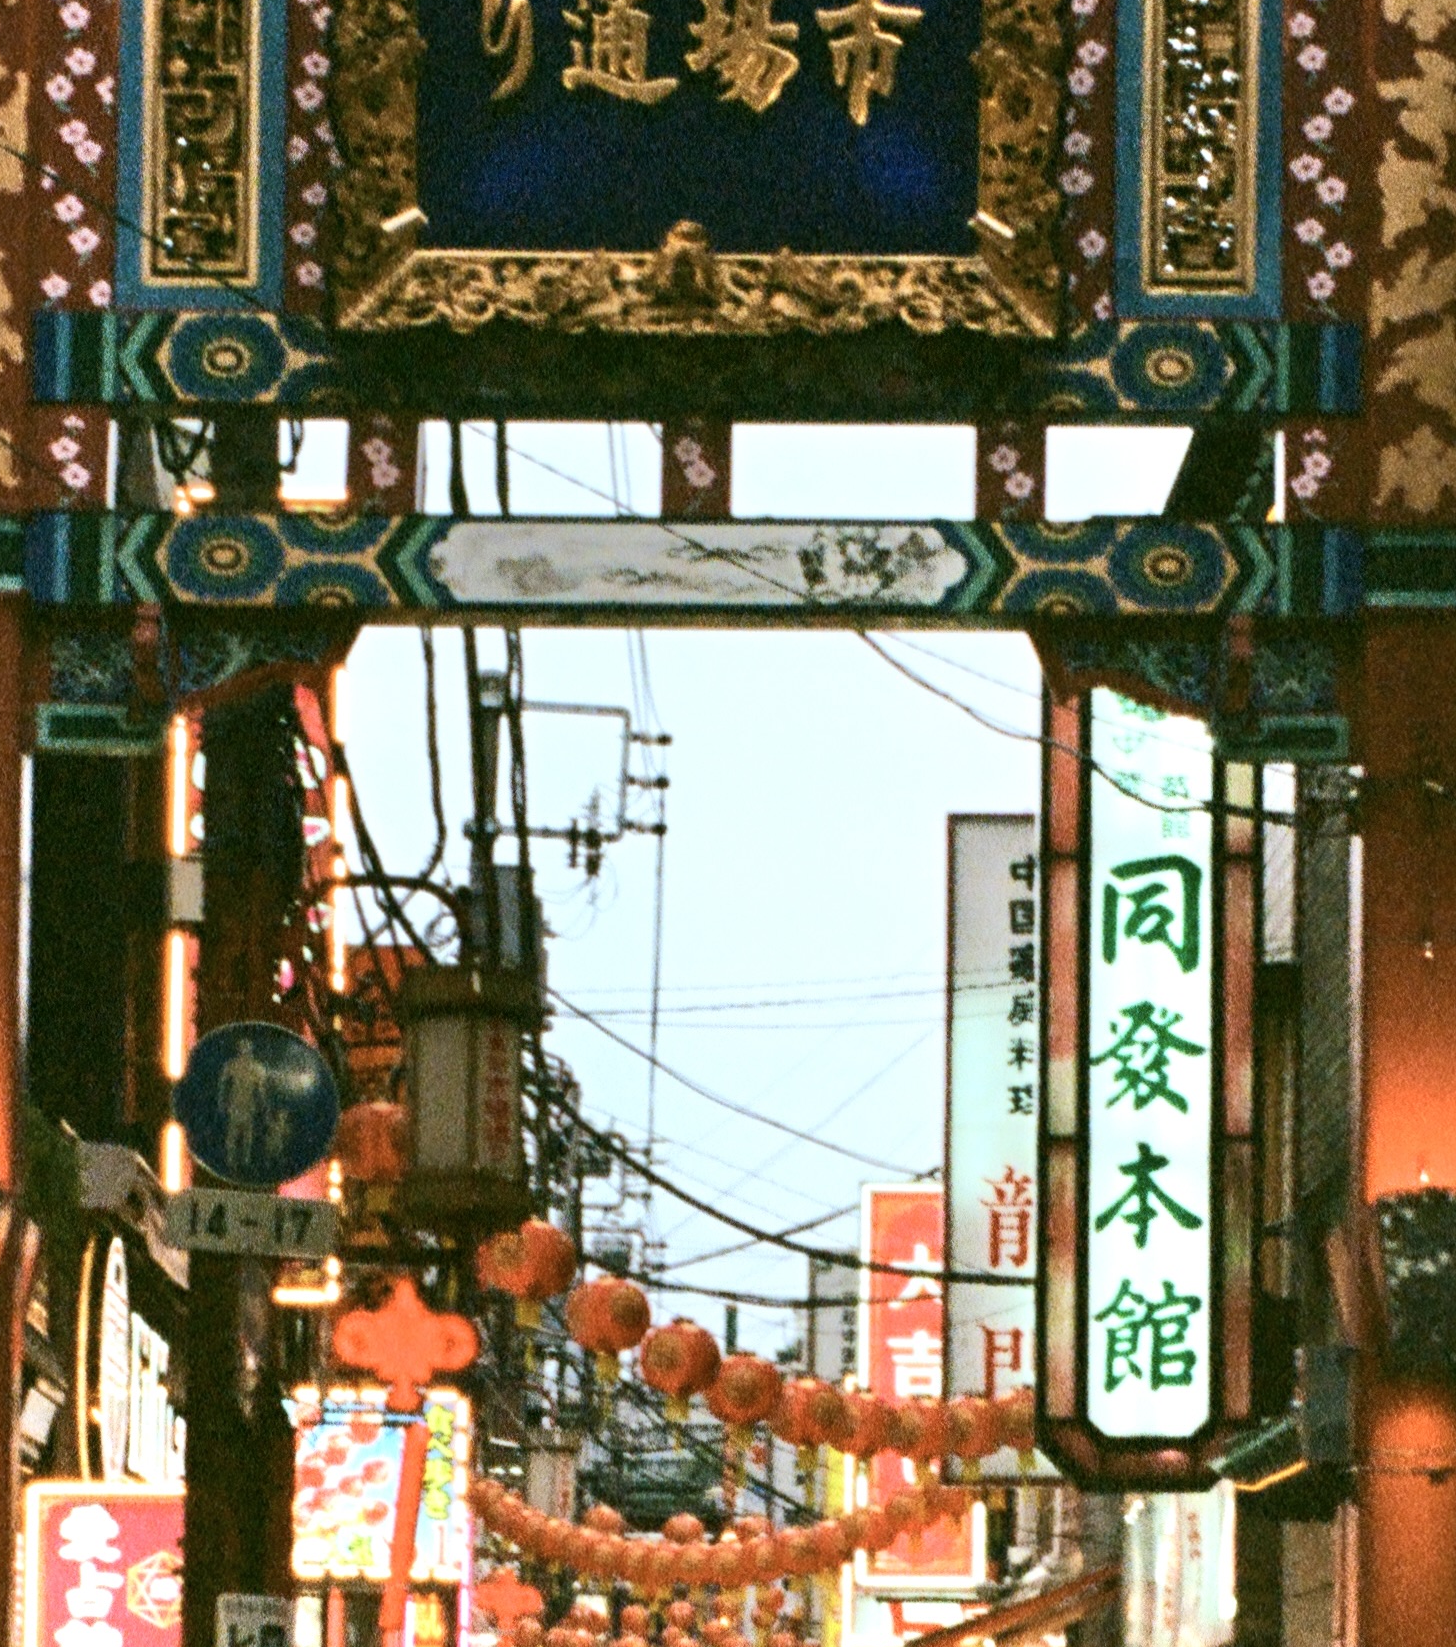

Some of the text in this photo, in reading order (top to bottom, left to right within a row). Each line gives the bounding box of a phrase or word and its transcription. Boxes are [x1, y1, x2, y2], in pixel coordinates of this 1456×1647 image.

[189, 1202, 314, 1246] 14-17
[1090, 853, 1205, 1394] 同發本館
